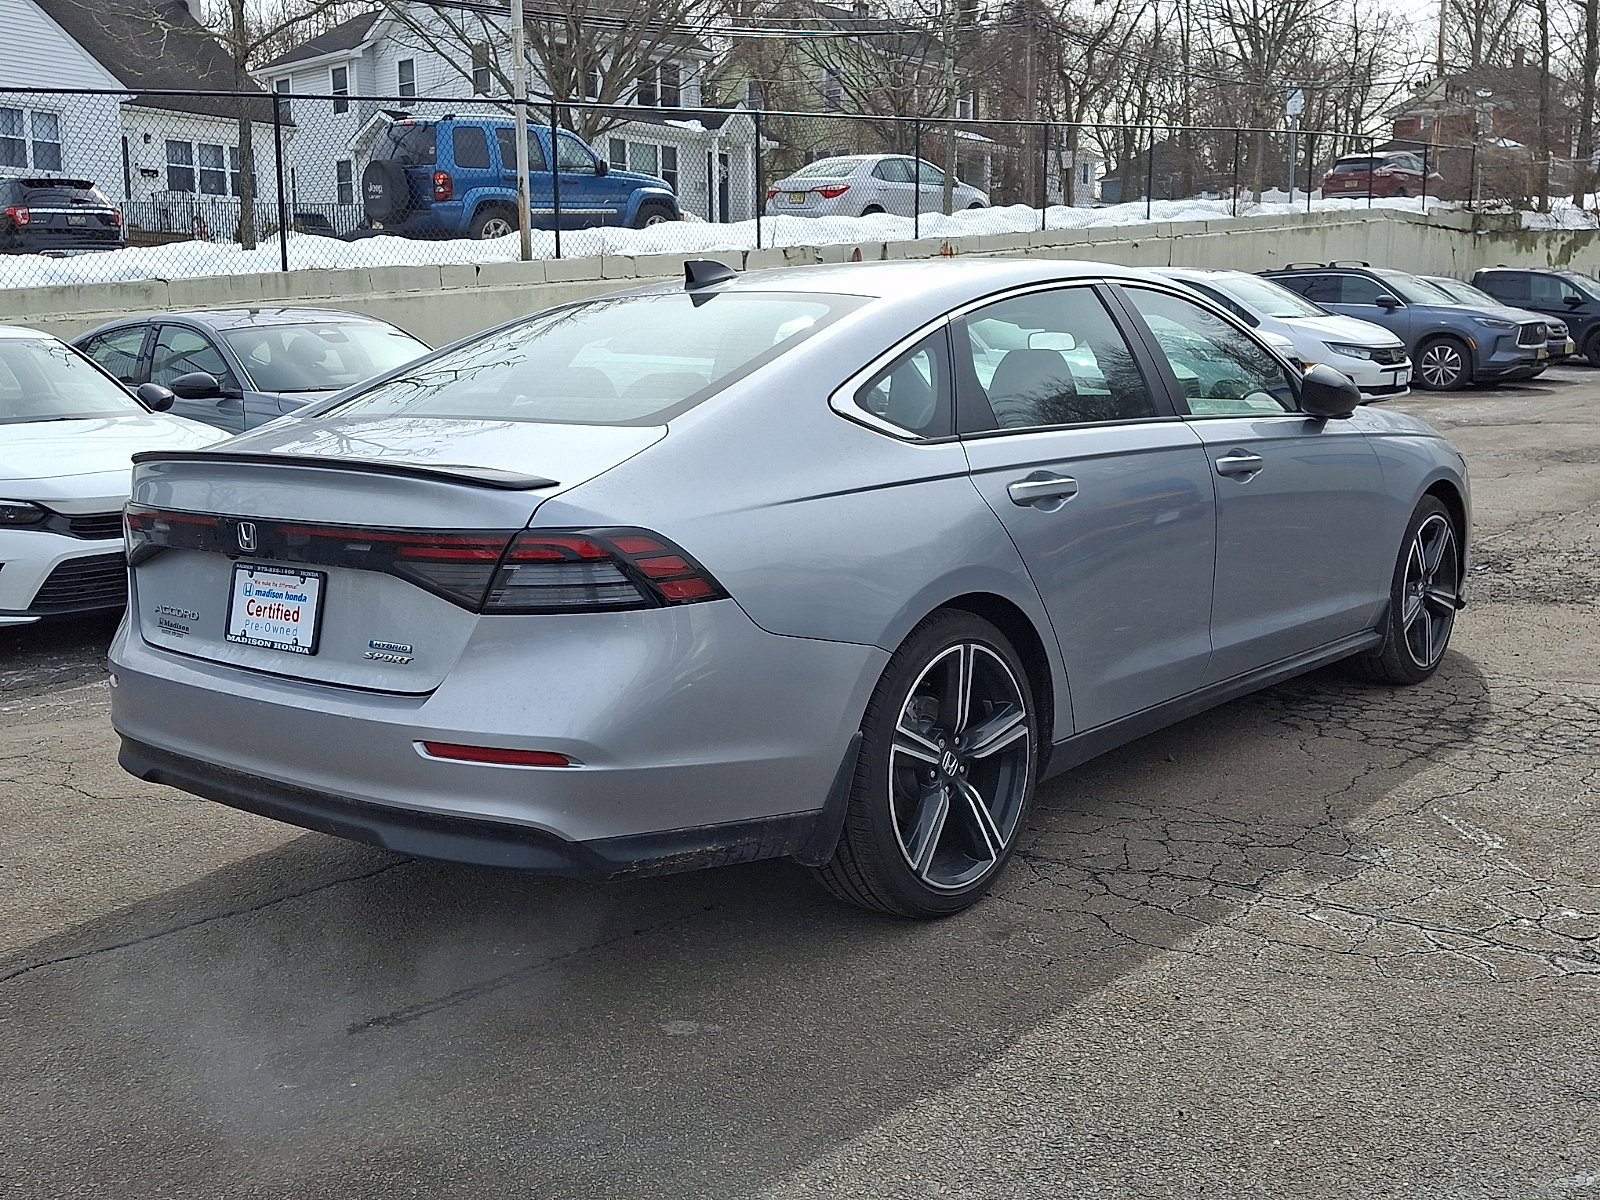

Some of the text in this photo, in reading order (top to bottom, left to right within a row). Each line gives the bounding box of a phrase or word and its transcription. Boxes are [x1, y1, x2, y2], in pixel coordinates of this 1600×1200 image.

[255, 589, 307, 602] madison honda
[155, 604, 199, 621] ACCORD
[246, 599, 300, 623] Certified
[164, 619, 190, 632] Madison
[245, 619, 298, 636] Pre-Owned
[226, 634, 309, 654] MADISON HONDA
[374, 642, 408, 651] HYBRID
[363, 651, 415, 665] SPORT
